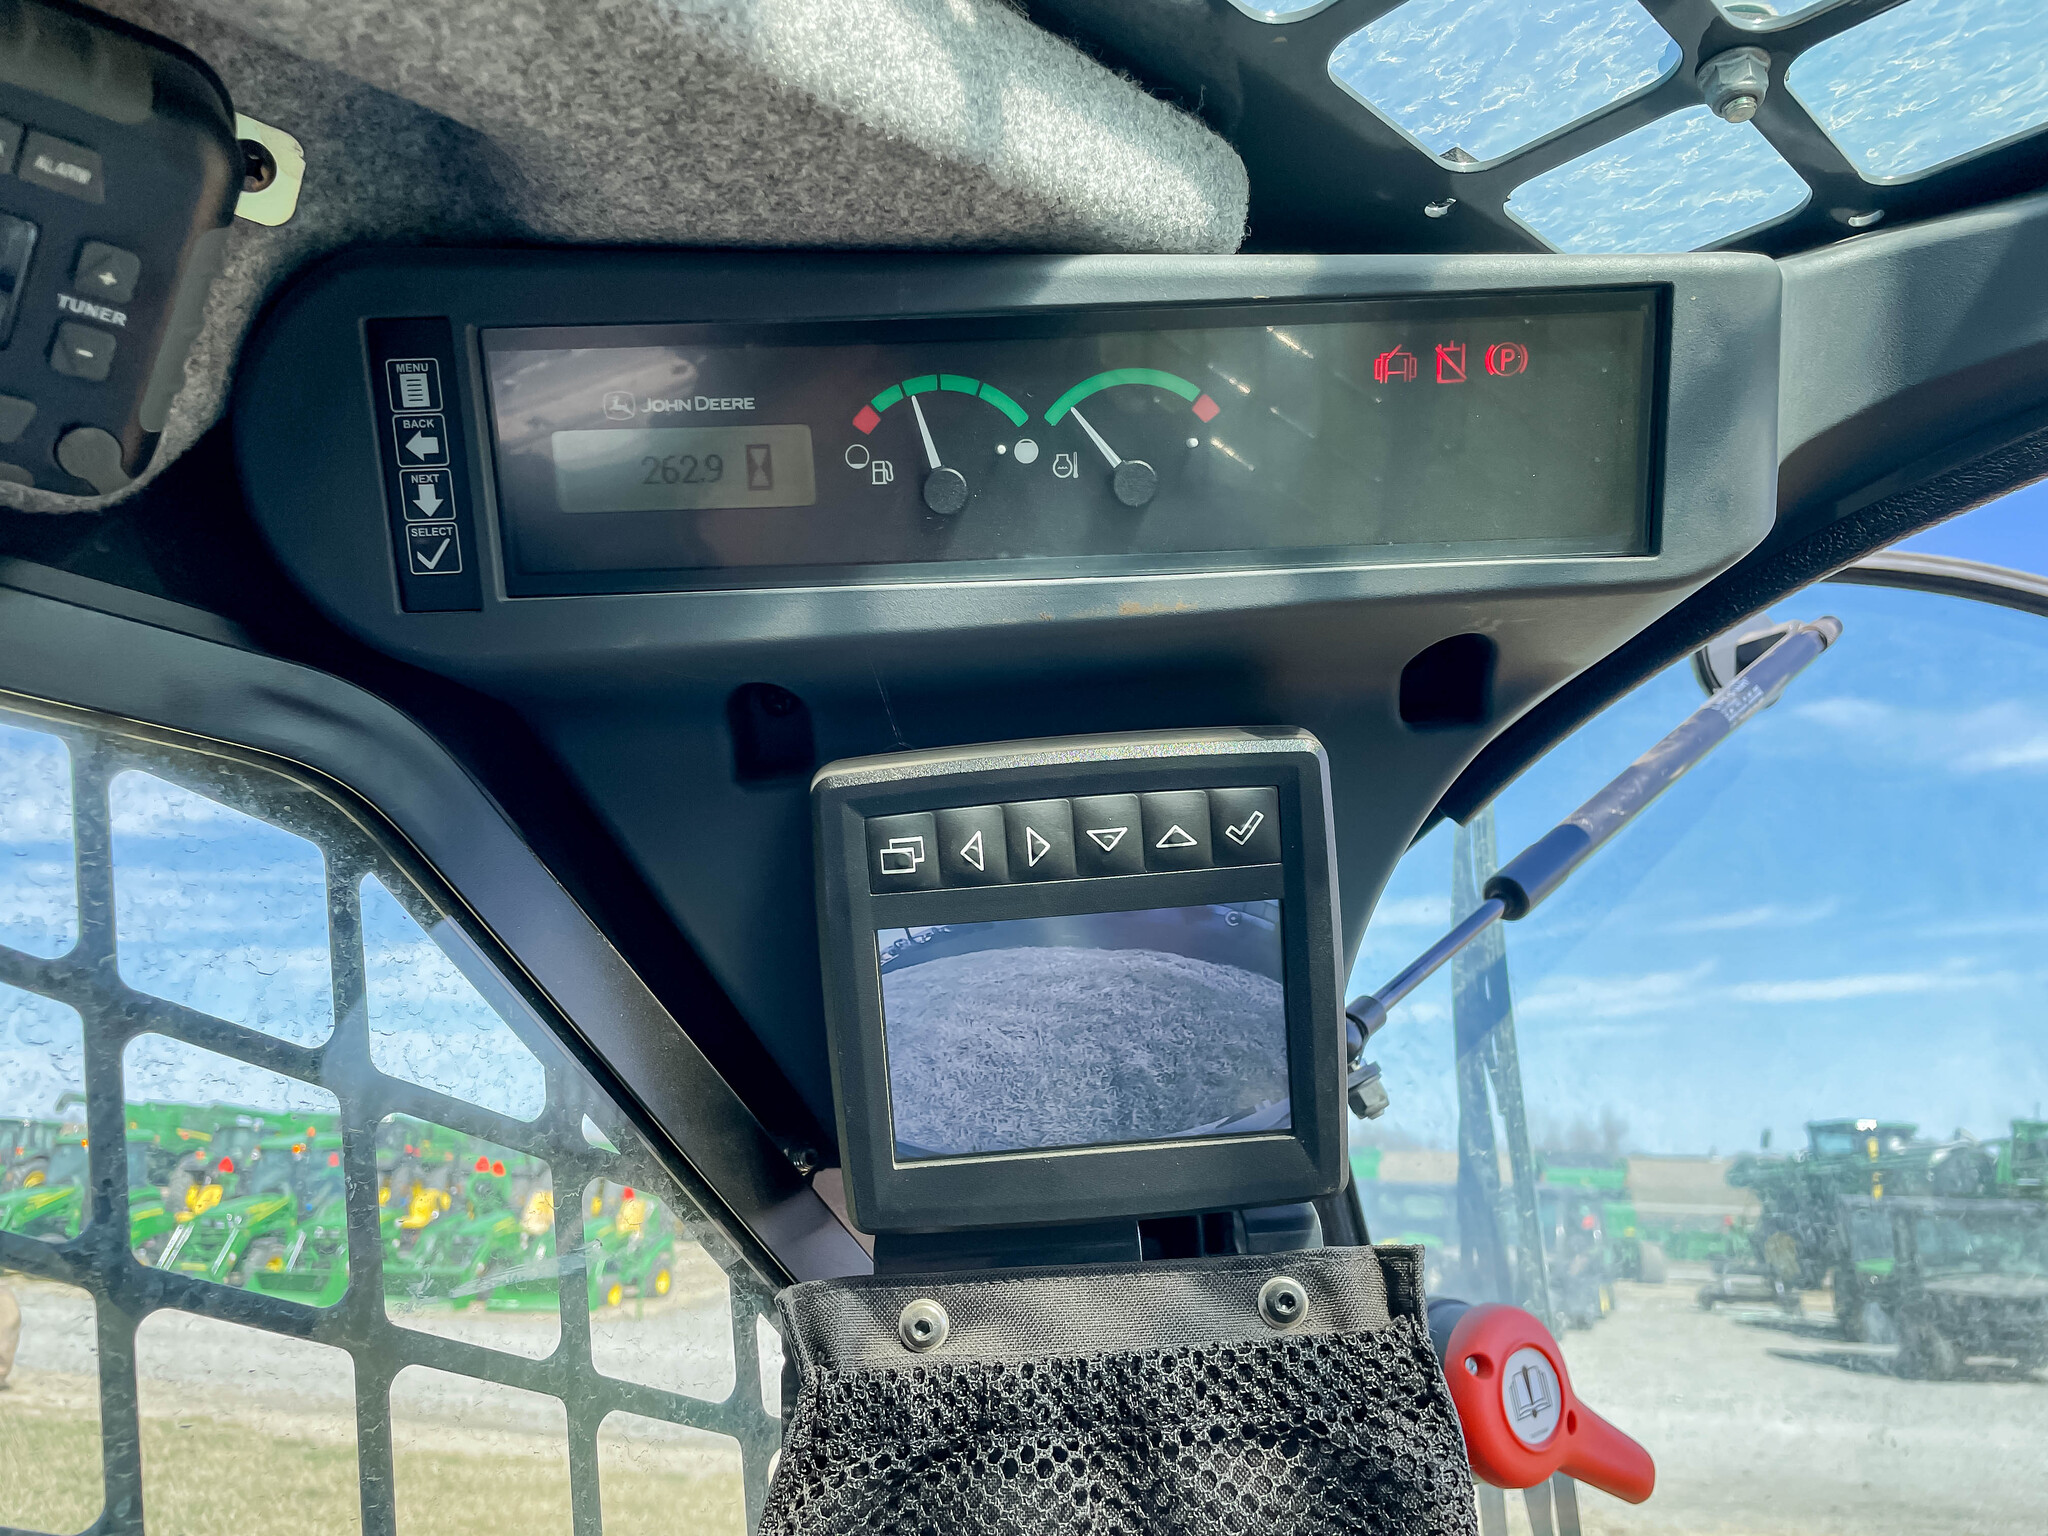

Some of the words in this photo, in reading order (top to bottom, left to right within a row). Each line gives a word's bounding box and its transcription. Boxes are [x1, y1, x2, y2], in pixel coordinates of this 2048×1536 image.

[57, 293, 127, 327] TUNER
[395, 363, 429, 373] MENU
[641, 397, 691, 413] JOHN
[694, 395, 756, 411] DEERE
[403, 419, 435, 429] BACK
[411, 474, 440, 484] NEXT
[411, 527, 453, 537] SELECT
